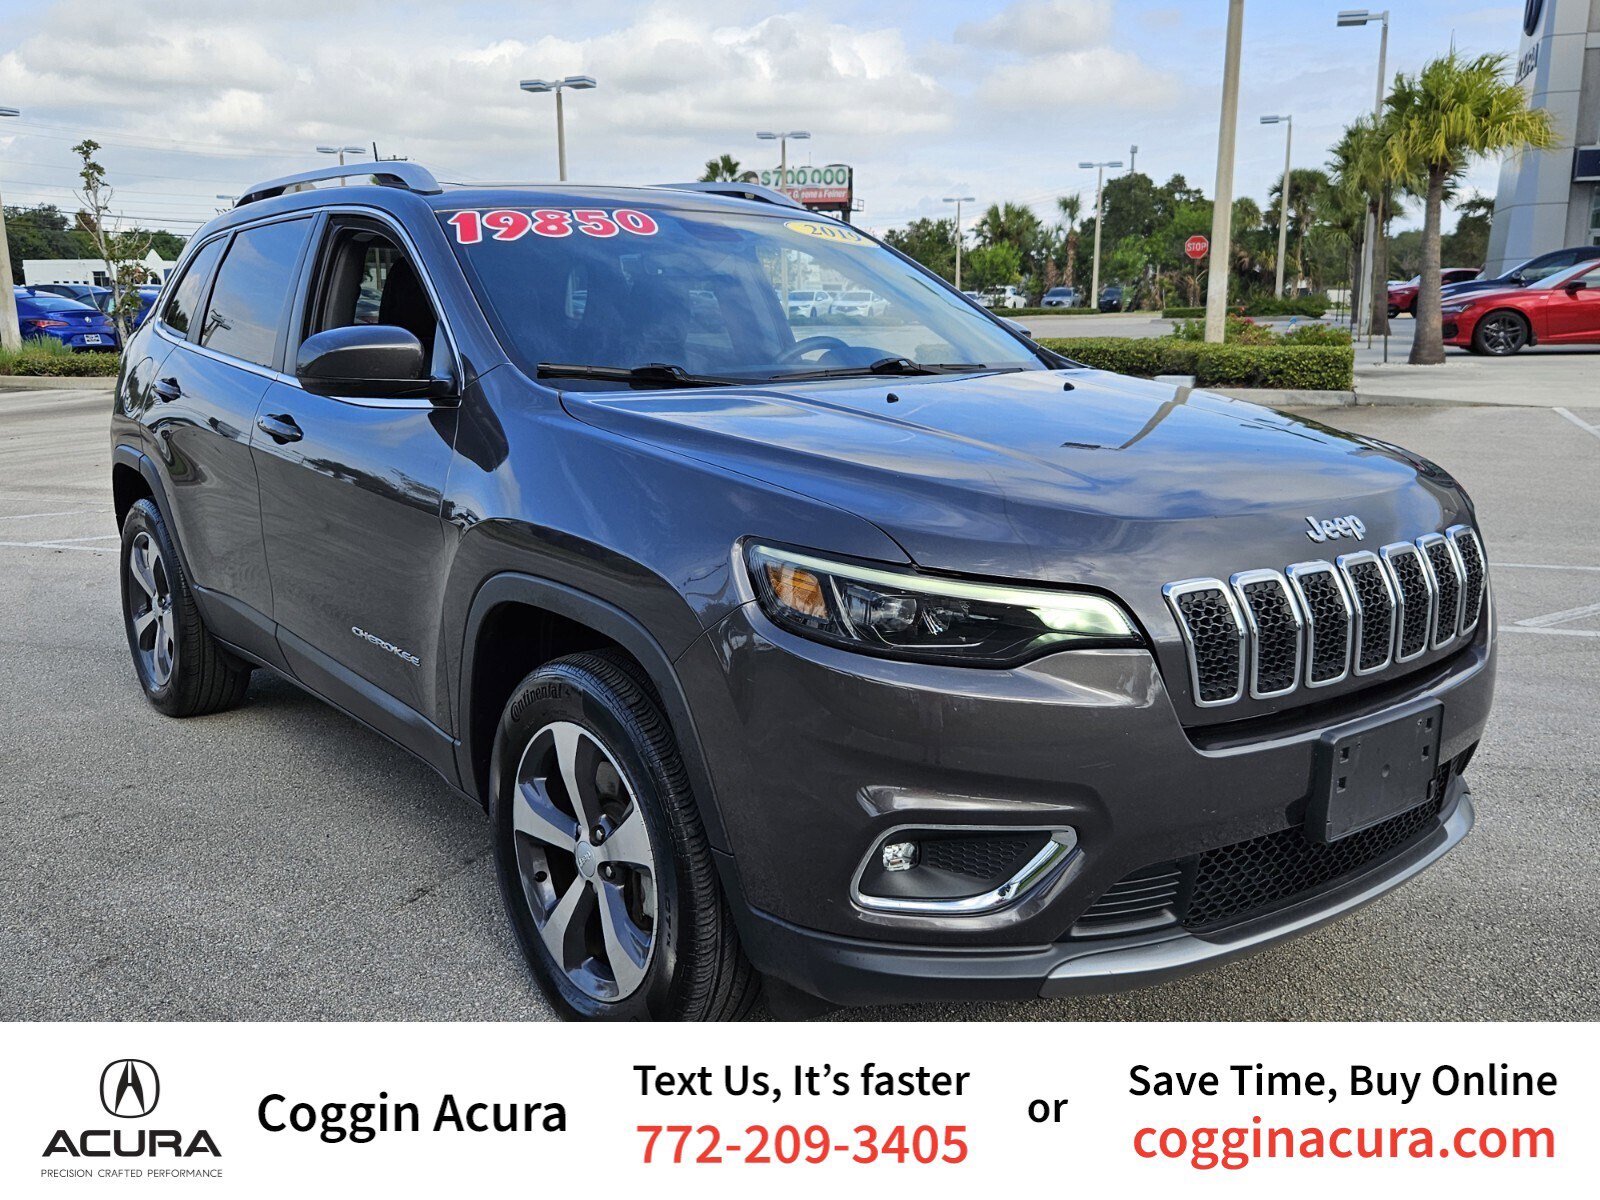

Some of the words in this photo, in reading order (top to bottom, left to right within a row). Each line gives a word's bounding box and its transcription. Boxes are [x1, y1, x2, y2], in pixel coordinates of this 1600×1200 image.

[447, 209, 659, 245] 19850
[803, 224, 862, 242] 2019
[1187, 242, 1207, 252] STOP
[1305, 514, 1366, 544] Jeep
[351, 626, 421, 667] CHEROKEE
[510, 682, 562, 723] Continental
